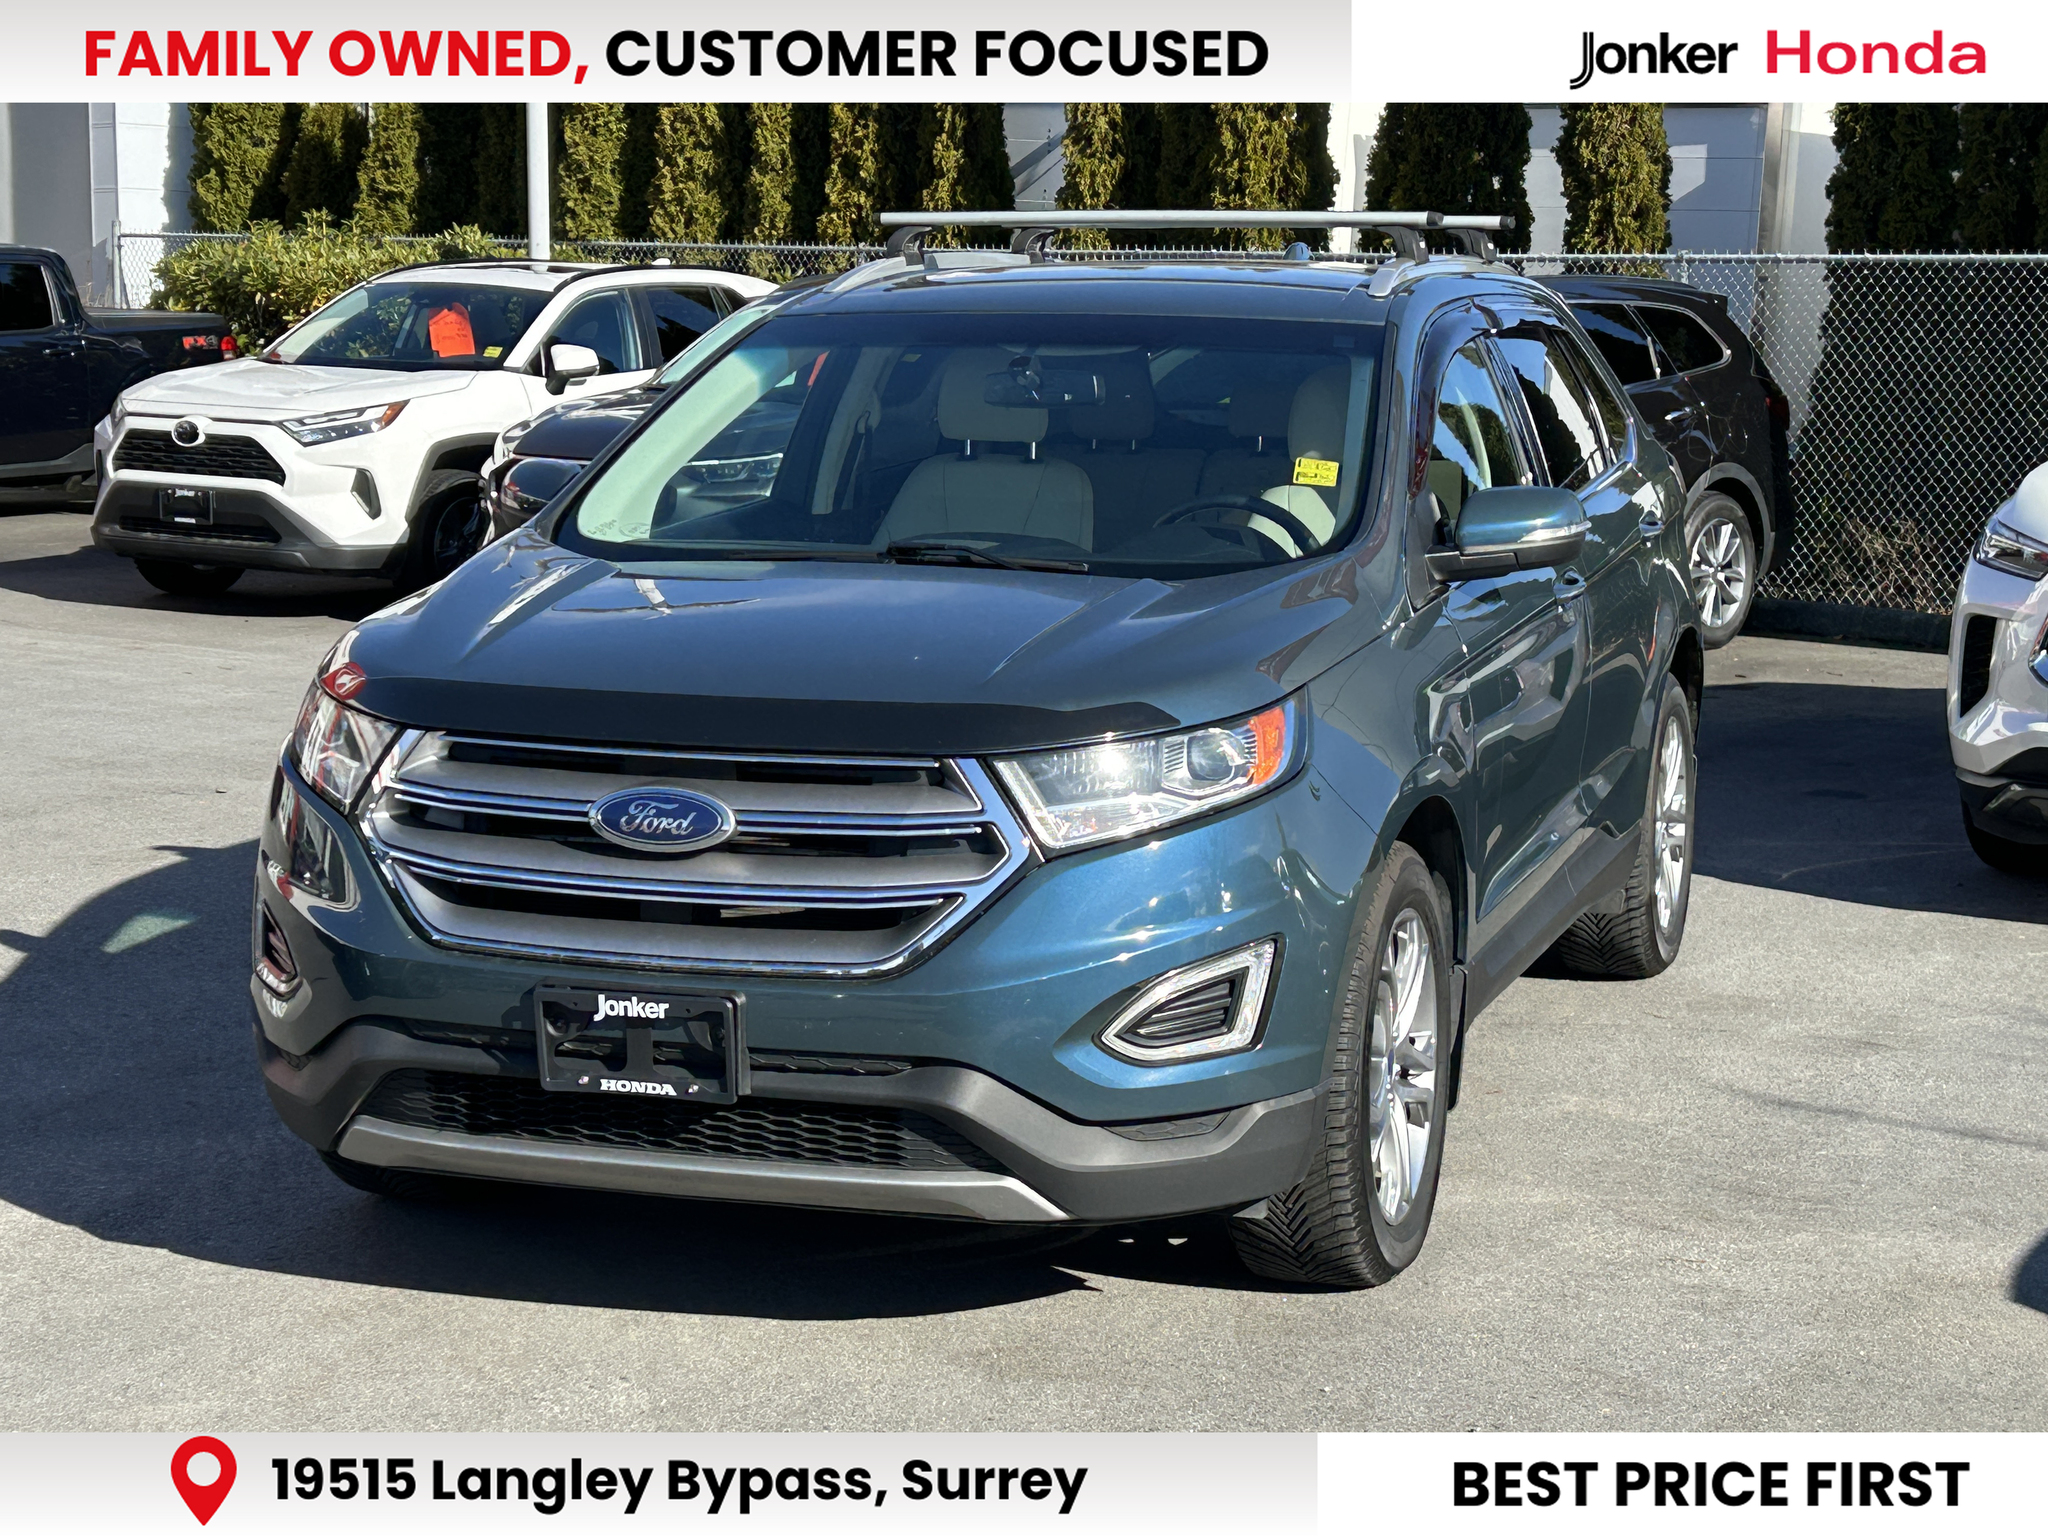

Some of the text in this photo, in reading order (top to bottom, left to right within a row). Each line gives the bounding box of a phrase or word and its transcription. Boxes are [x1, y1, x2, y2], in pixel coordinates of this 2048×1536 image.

[620, 800, 697, 835] Ford
[593, 994, 669, 1021] Jonker
[600, 1078, 677, 1096] HONDA
